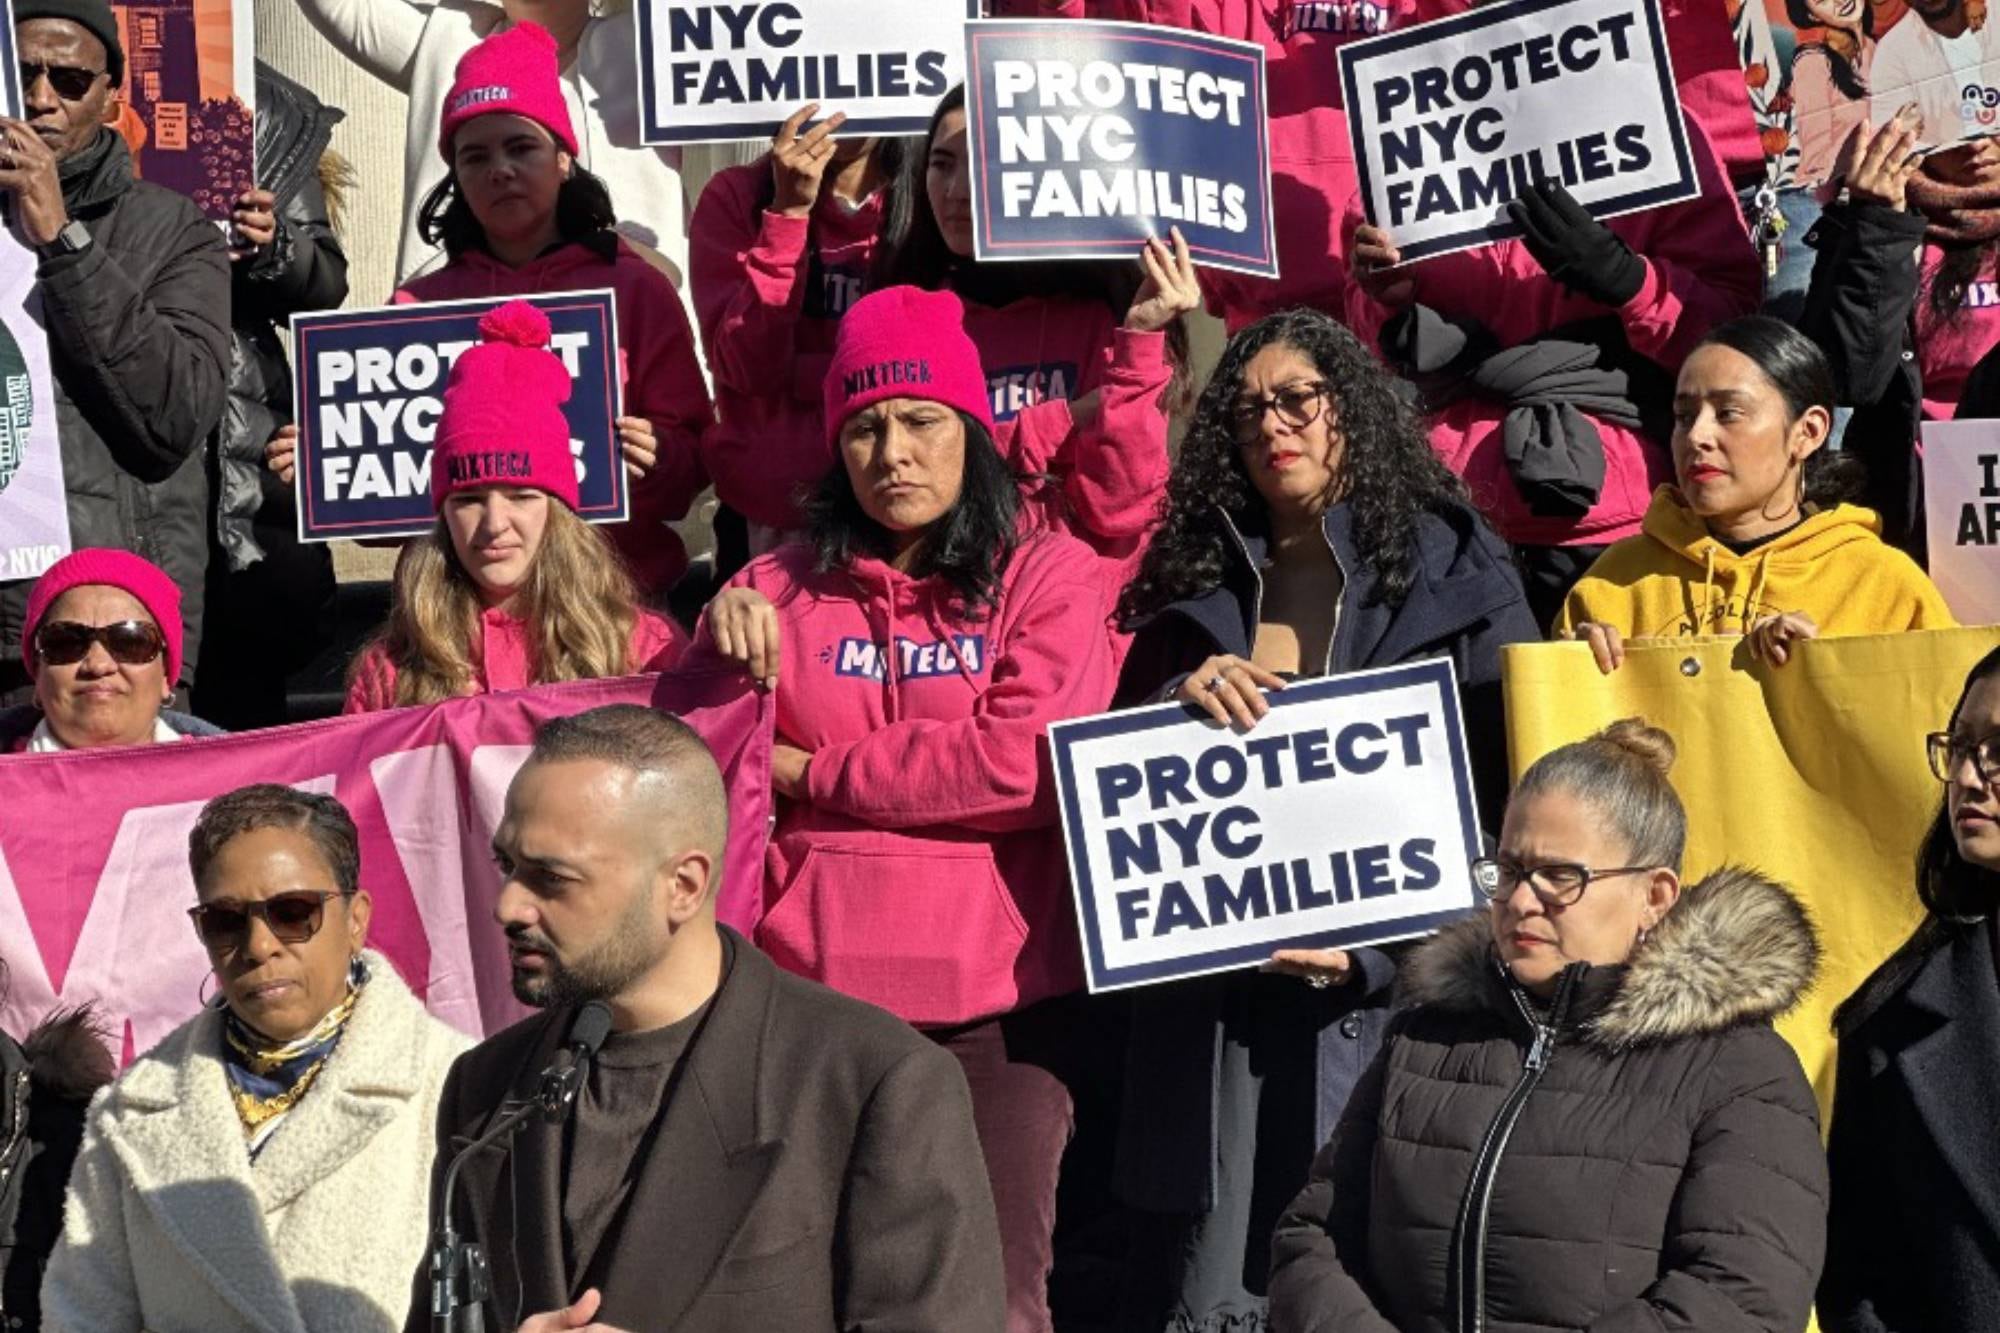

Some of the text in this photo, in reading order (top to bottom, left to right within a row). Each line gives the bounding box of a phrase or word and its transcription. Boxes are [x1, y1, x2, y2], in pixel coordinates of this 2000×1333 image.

[669, 3, 803, 52] NYC
[671, 50, 948, 105] FAMILIES
[994, 60, 1246, 126] PROTECT
[1373, 11, 1635, 124] PROTECT
[997, 113, 1137, 163] NYC
[1380, 107, 1506, 176] NYC
[1002, 168, 1248, 233] FAMILIES
[1386, 124, 1653, 227] FAMILIES
[843, 361, 932, 400] MIXTECA
[319, 395, 445, 450] NYC
[448, 452, 531, 483] MIXTECA
[1095, 713, 1431, 819] PROTECT
[1106, 805, 1263, 880] NYC
[1116, 838, 1442, 941] FAMILIES
